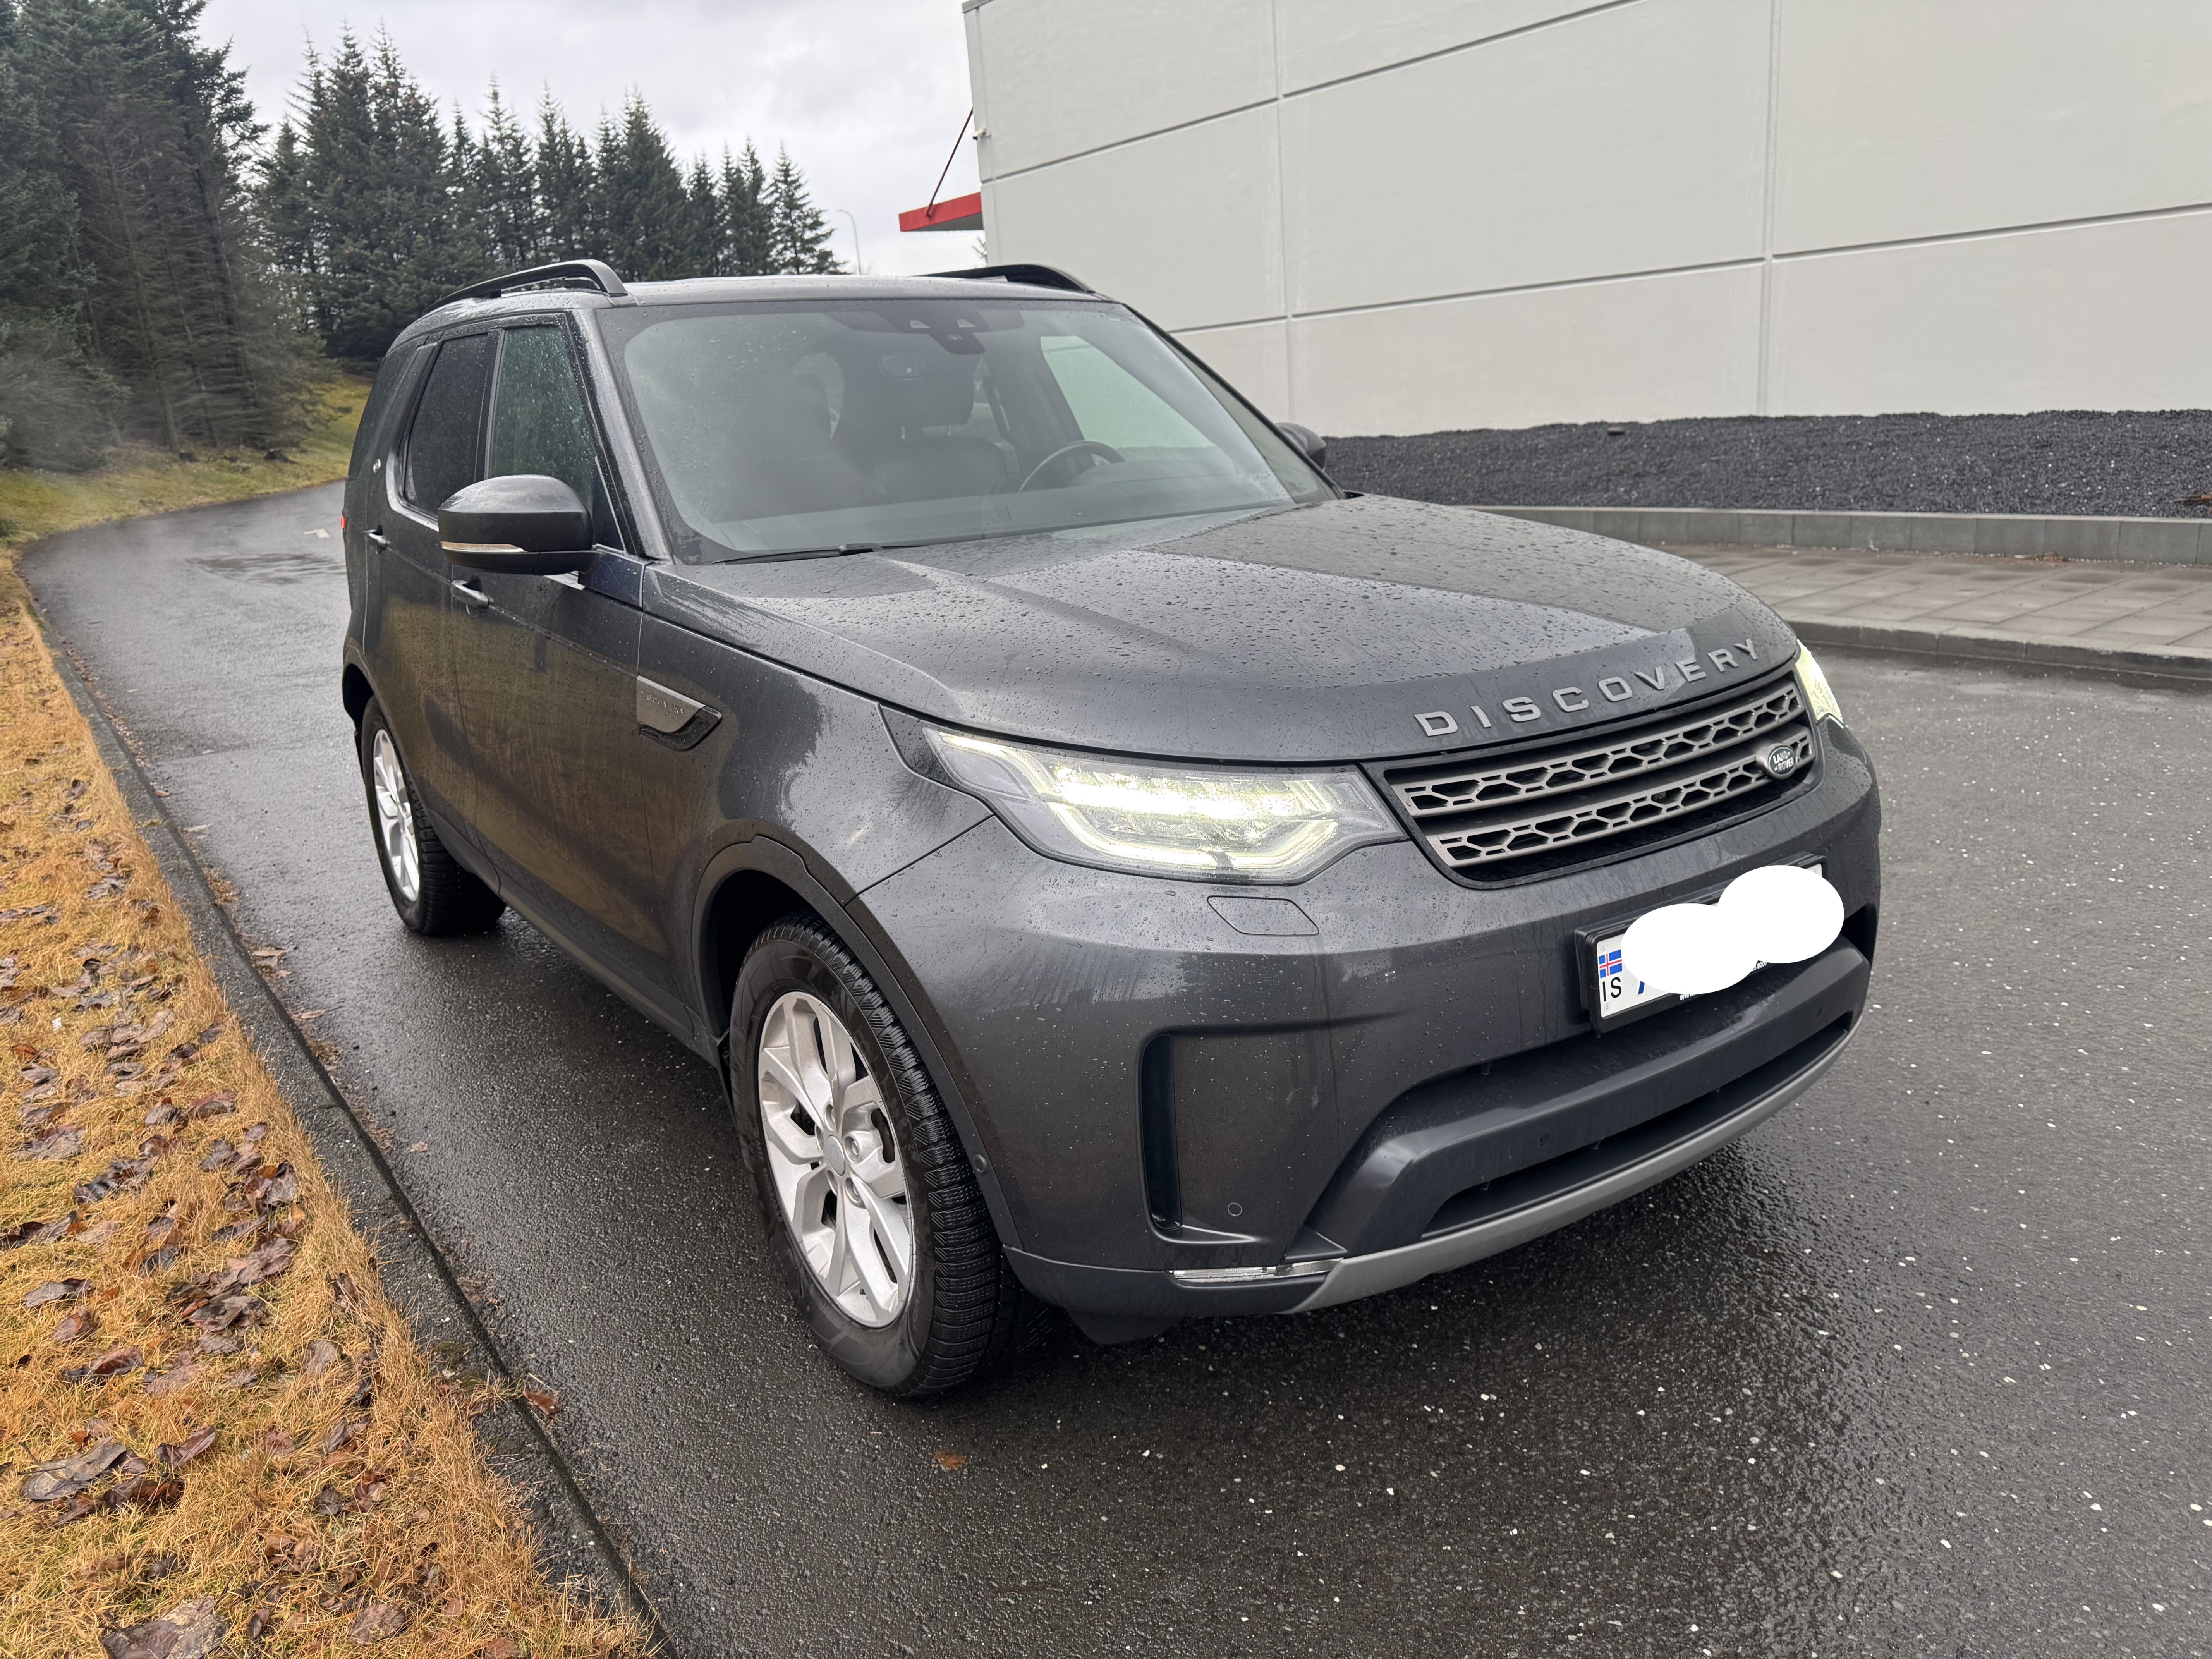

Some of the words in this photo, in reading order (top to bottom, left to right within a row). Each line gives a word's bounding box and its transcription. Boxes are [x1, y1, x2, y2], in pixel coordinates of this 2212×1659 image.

[1414, 638, 1758, 737] DISCOVERY
[1773, 750, 1788, 764] LAND
[1778, 757, 1794, 772] ROVER
[1602, 977, 1622, 1002] IS
